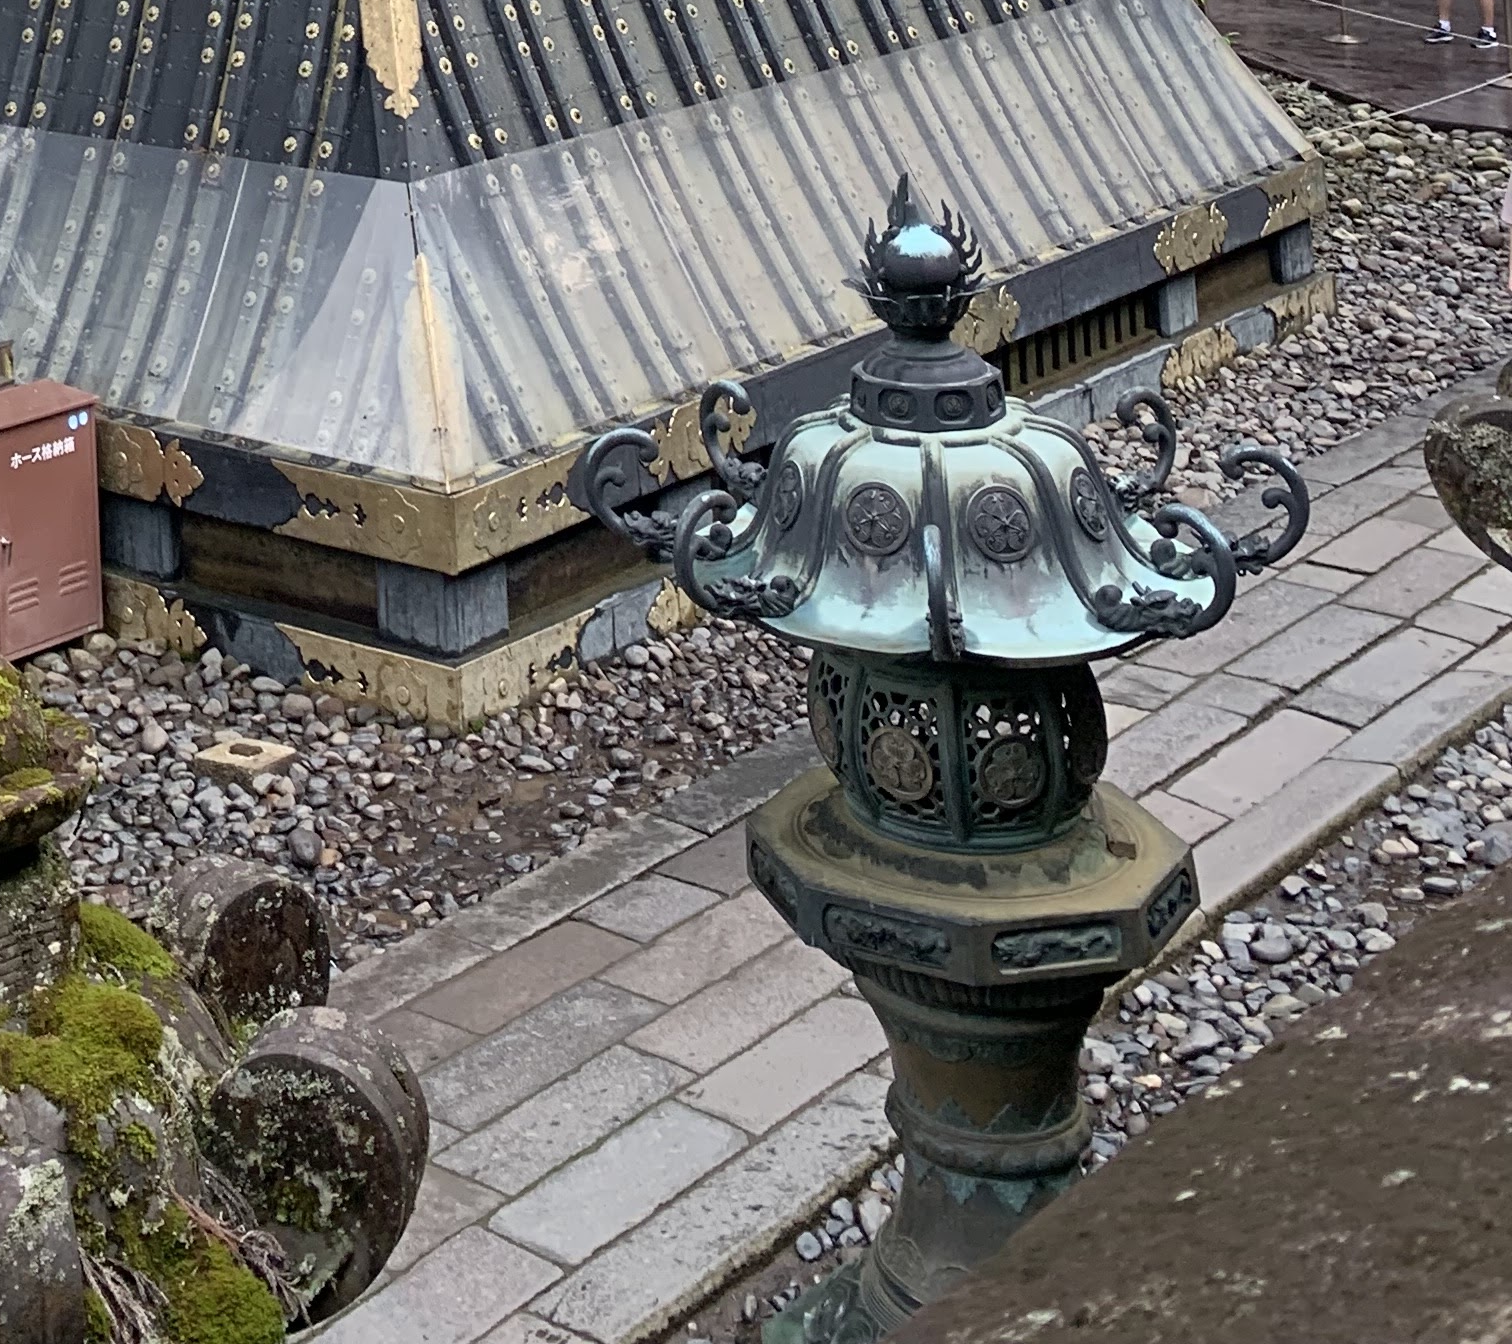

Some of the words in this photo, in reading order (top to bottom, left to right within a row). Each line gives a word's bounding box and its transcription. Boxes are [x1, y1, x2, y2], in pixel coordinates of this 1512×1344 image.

[10, 436, 75, 469] ホース格納箱
